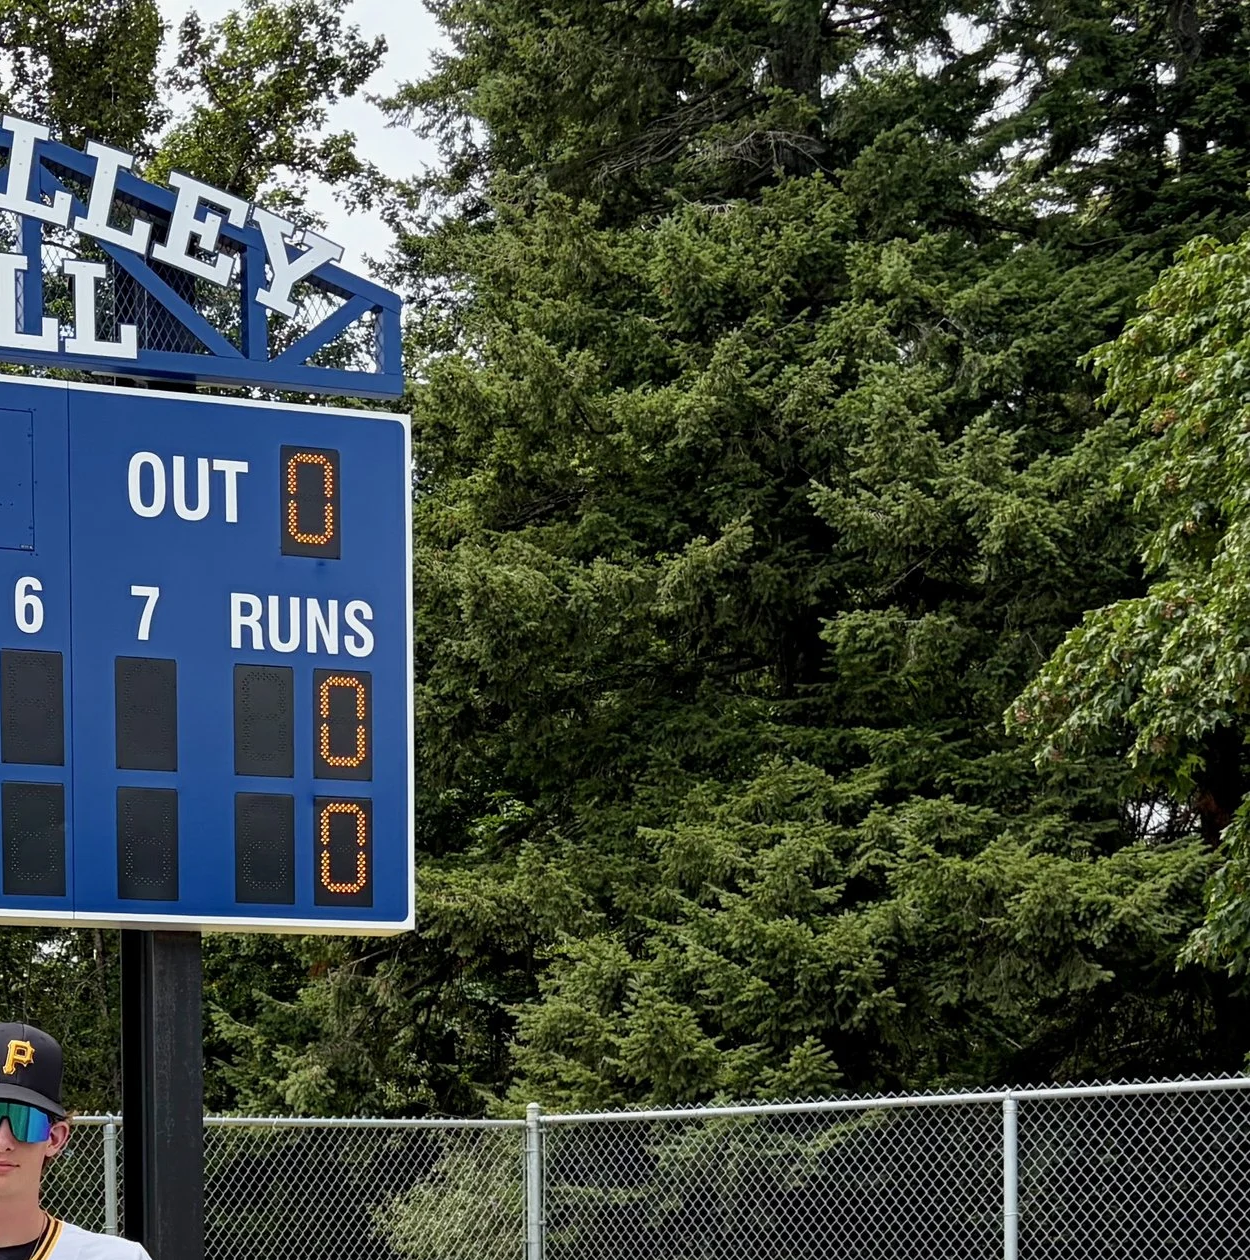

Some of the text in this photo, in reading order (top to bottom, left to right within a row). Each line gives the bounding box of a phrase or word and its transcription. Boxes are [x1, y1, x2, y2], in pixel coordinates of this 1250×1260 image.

[128, 451, 249, 523] OUT
[286, 452, 335, 546] 0
[14, 576, 45, 634] 6
[130, 585, 160, 641] 7
[229, 592, 375, 658] RUNS
[319, 674, 367, 768] 0
[320, 802, 367, 893] 0
[2, 1039, 36, 1075] P
